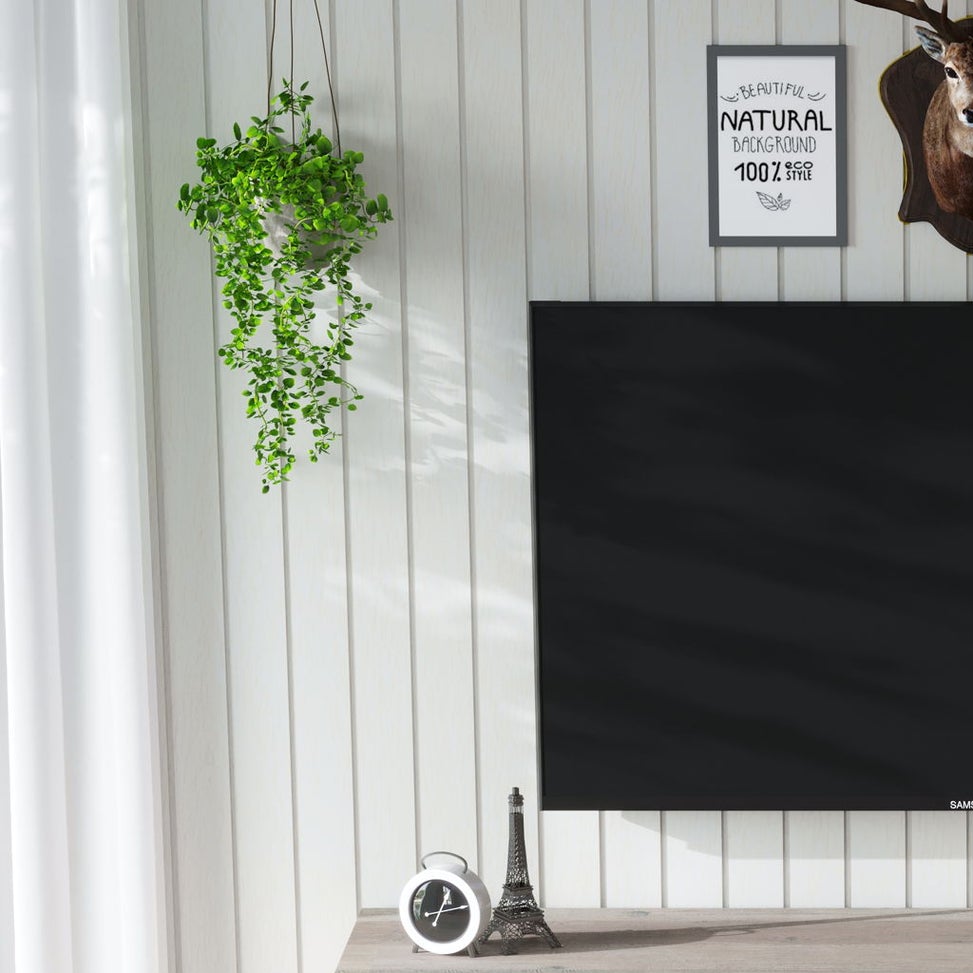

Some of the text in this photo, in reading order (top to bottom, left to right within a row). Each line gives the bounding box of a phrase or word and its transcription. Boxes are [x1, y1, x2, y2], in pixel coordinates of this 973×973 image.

[739, 82, 805, 100] BEAUTIFUL
[720, 109, 833, 131] NATURAL
[731, 136, 817, 153] BACKGROUND
[734, 161, 782, 182] 100%
[786, 170, 813, 181] STYLE
